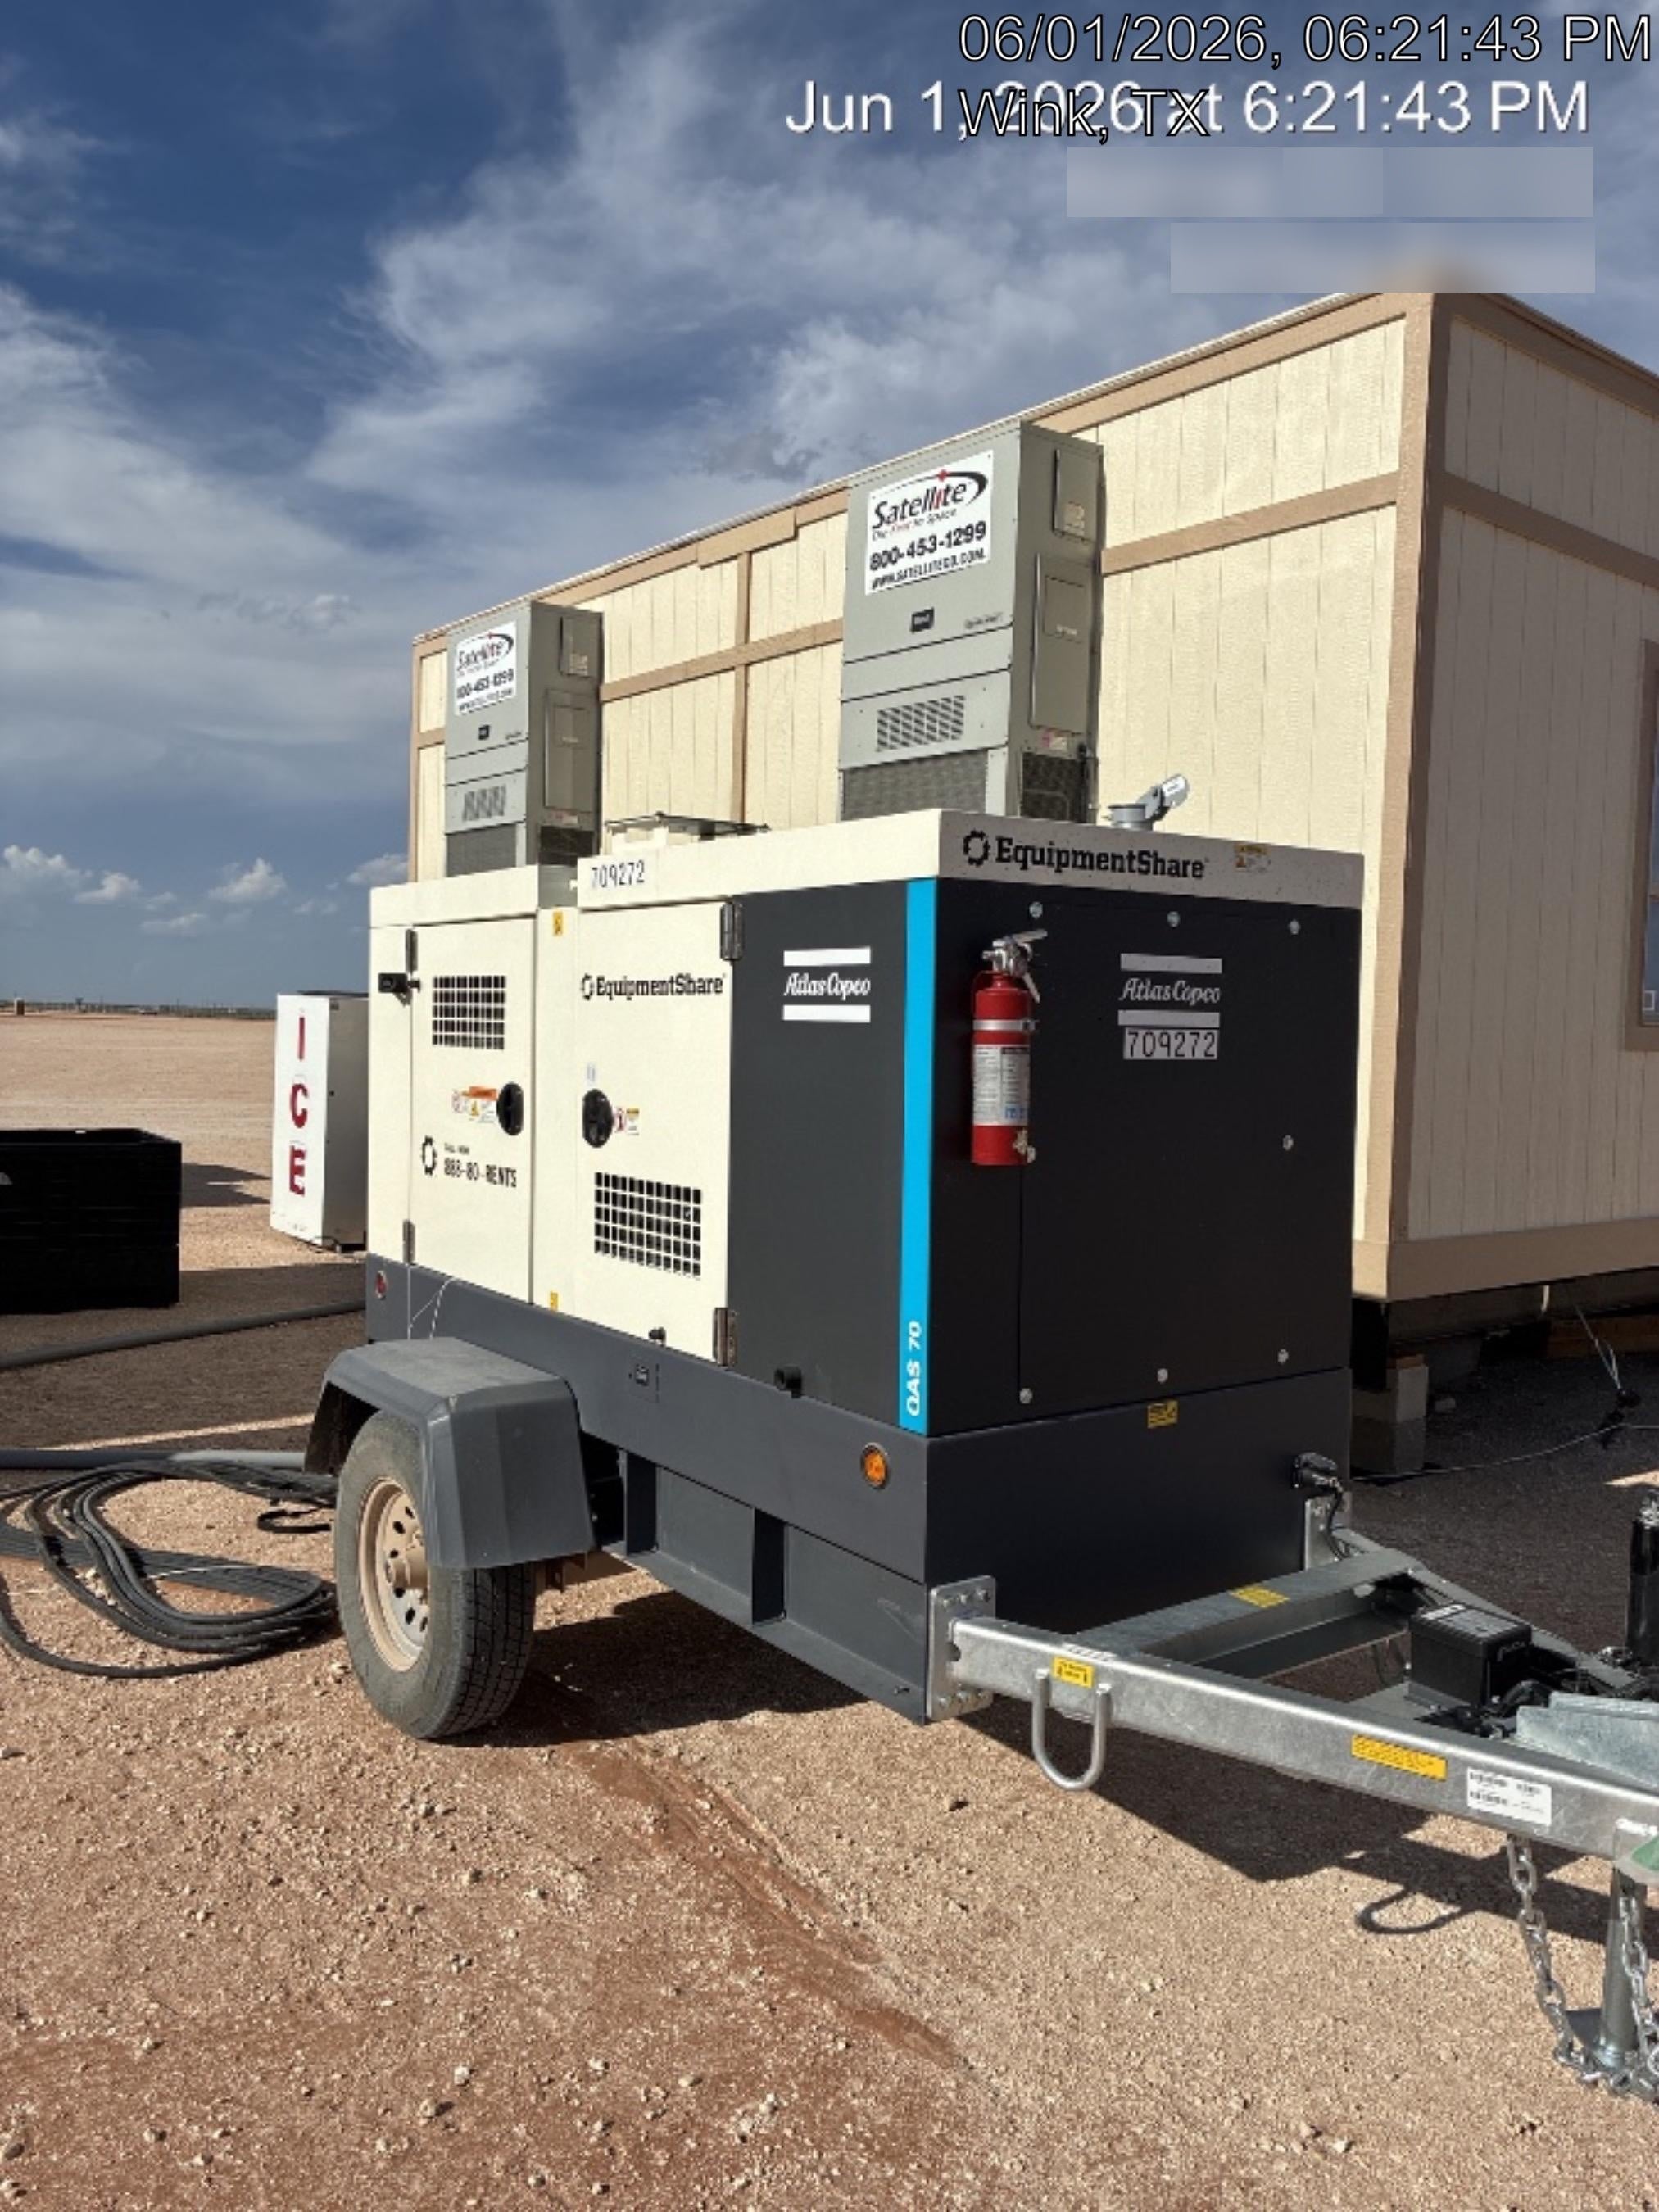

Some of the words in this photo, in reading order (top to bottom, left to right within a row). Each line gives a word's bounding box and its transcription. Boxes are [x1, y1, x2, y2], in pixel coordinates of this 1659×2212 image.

[872, 483, 967, 529] Satellite
[869, 521, 986, 571] 800-453-1299
[592, 860, 645, 888] 709272
[995, 836, 1205, 879] EquipmentShare
[596, 973, 723, 1000] EquipmentShare
[1127, 1031, 1215, 1058] 709272
[289, 1016, 309, 1197] ICE
[908, 1321, 922, 1352] 70
